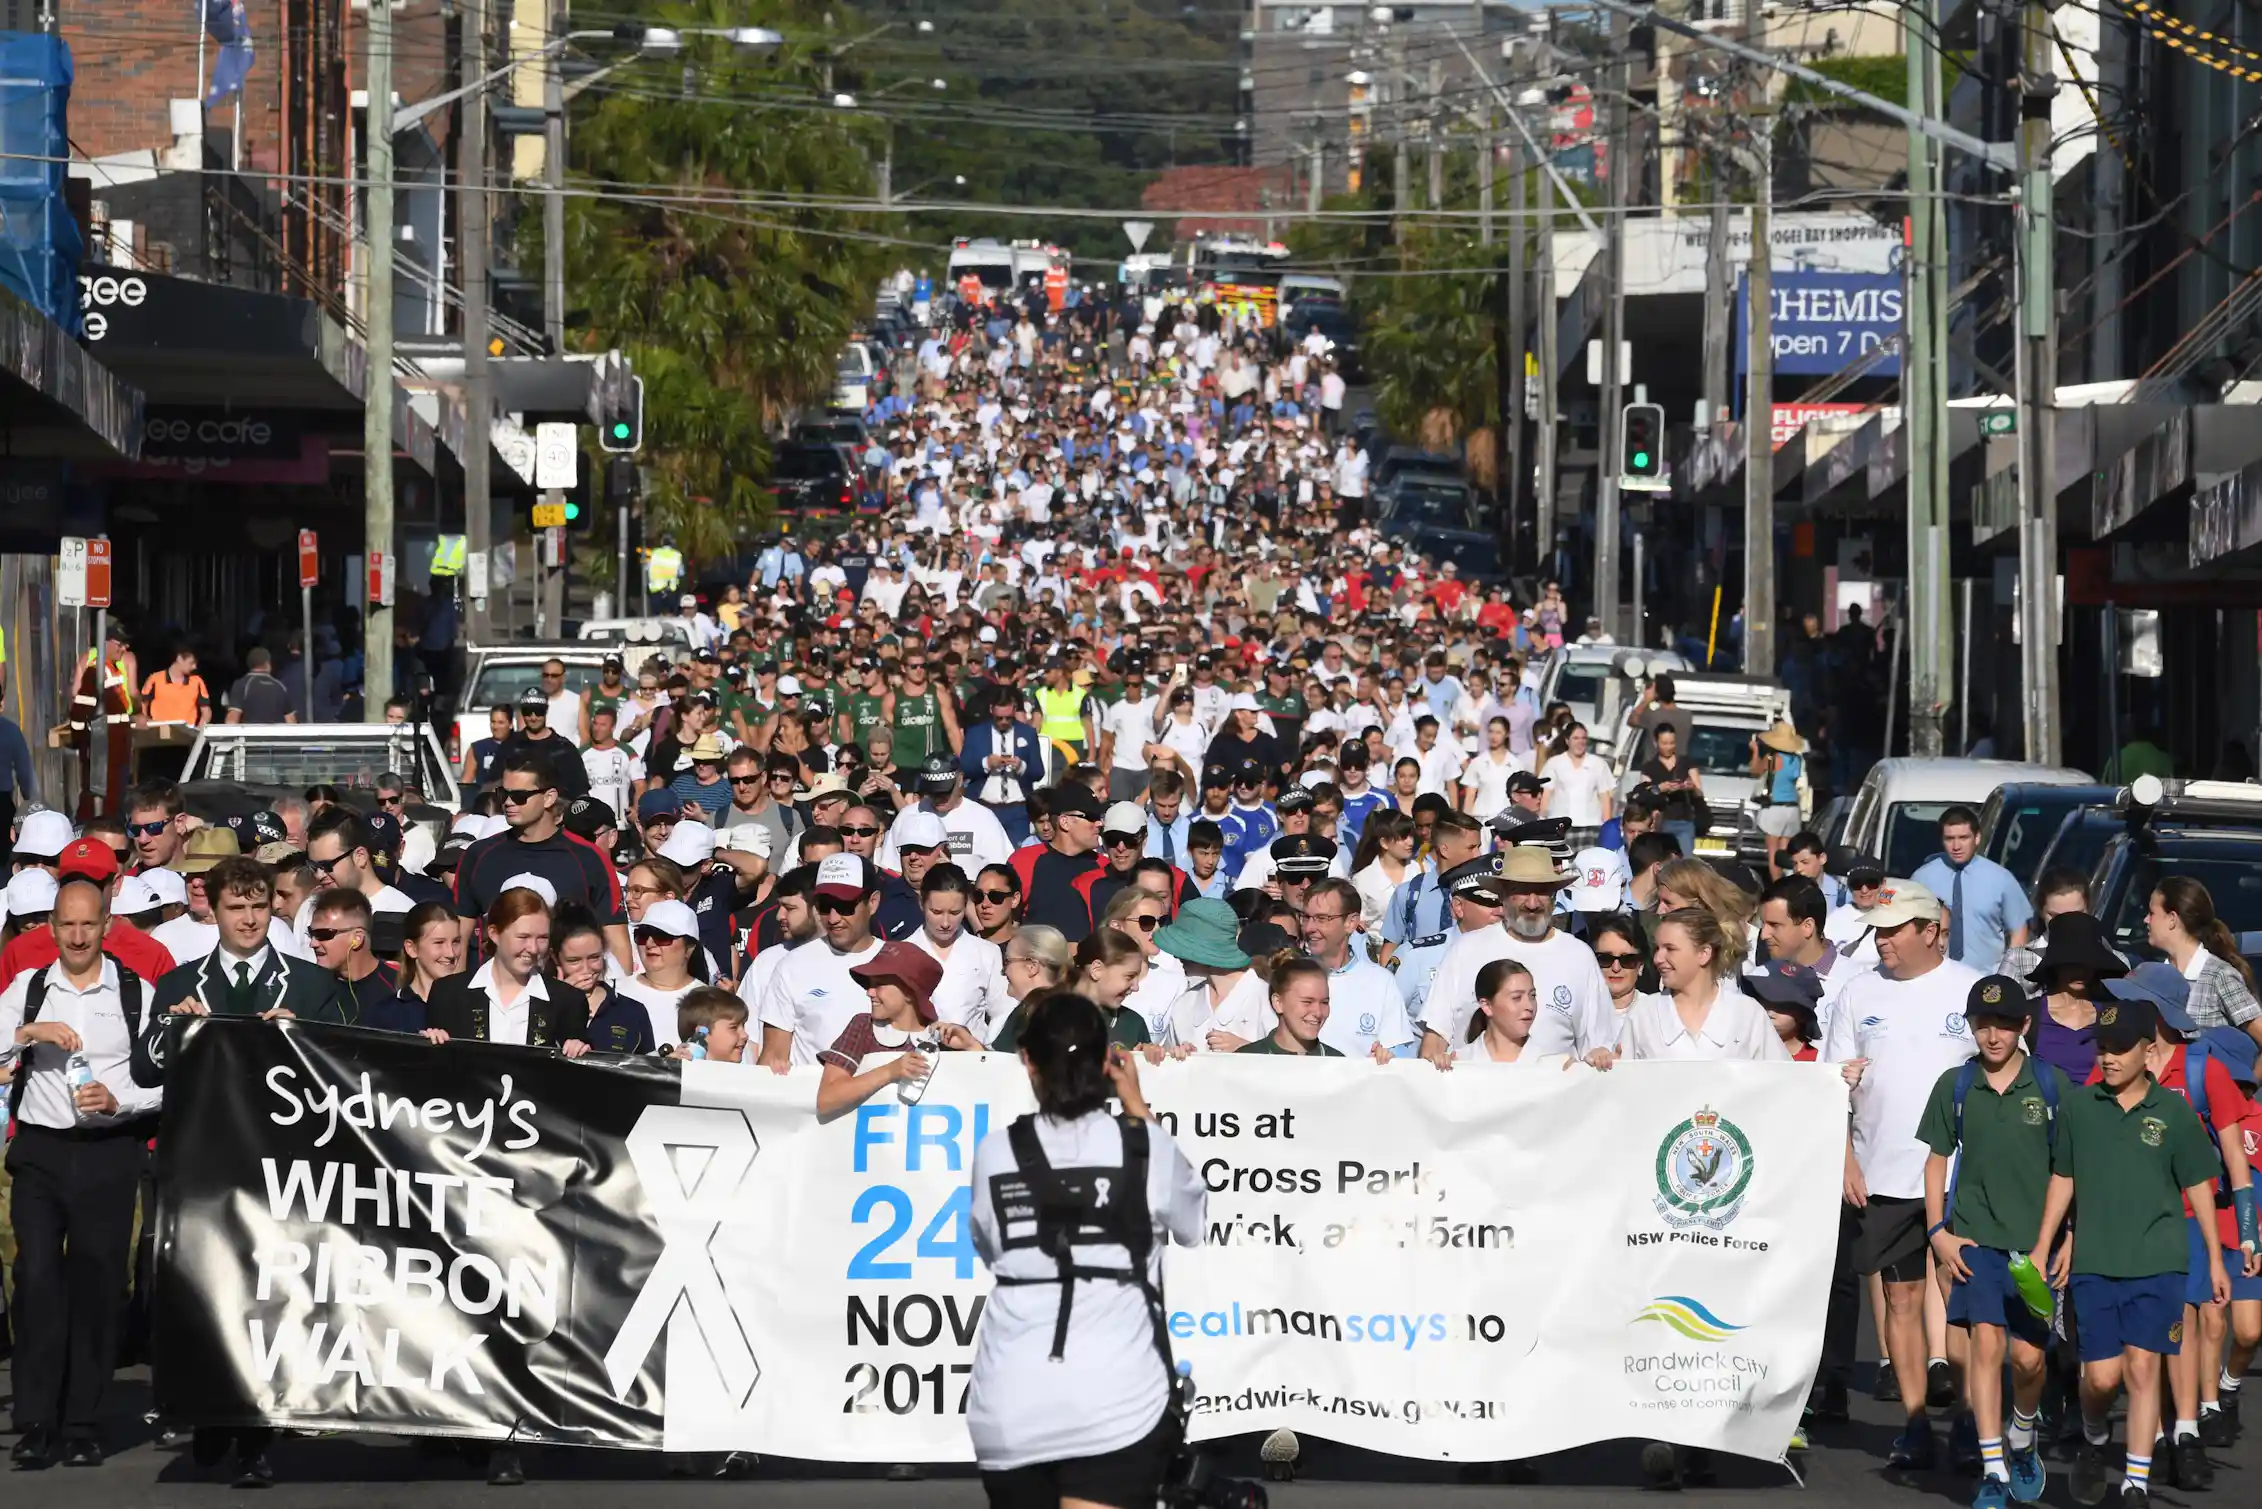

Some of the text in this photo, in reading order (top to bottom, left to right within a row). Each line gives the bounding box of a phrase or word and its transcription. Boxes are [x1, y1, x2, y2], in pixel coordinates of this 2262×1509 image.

[1770, 288, 1903, 323] HEMIS
[1769, 333, 1828, 360] pen
[264, 1065, 540, 1163] Sydney's
[853, 1103, 989, 1173] FRI
[1194, 1112, 1241, 1138] us
[1254, 1107, 1296, 1139] at
[261, 1157, 515, 1235] WHITE
[1200, 1157, 1322, 1194] Cross
[846, 1184, 981, 1280] 24
[1626, 1231, 1769, 1252] NSW Police Force
[255, 1240, 559, 1319] RIBBON
[846, 1293, 988, 1348] NOV
[248, 1318, 491, 1395] WALK
[1623, 1351, 1768, 1380] Randwick City
[1654, 1373, 1742, 1392] Council
[842, 1362, 975, 1415] 2017
